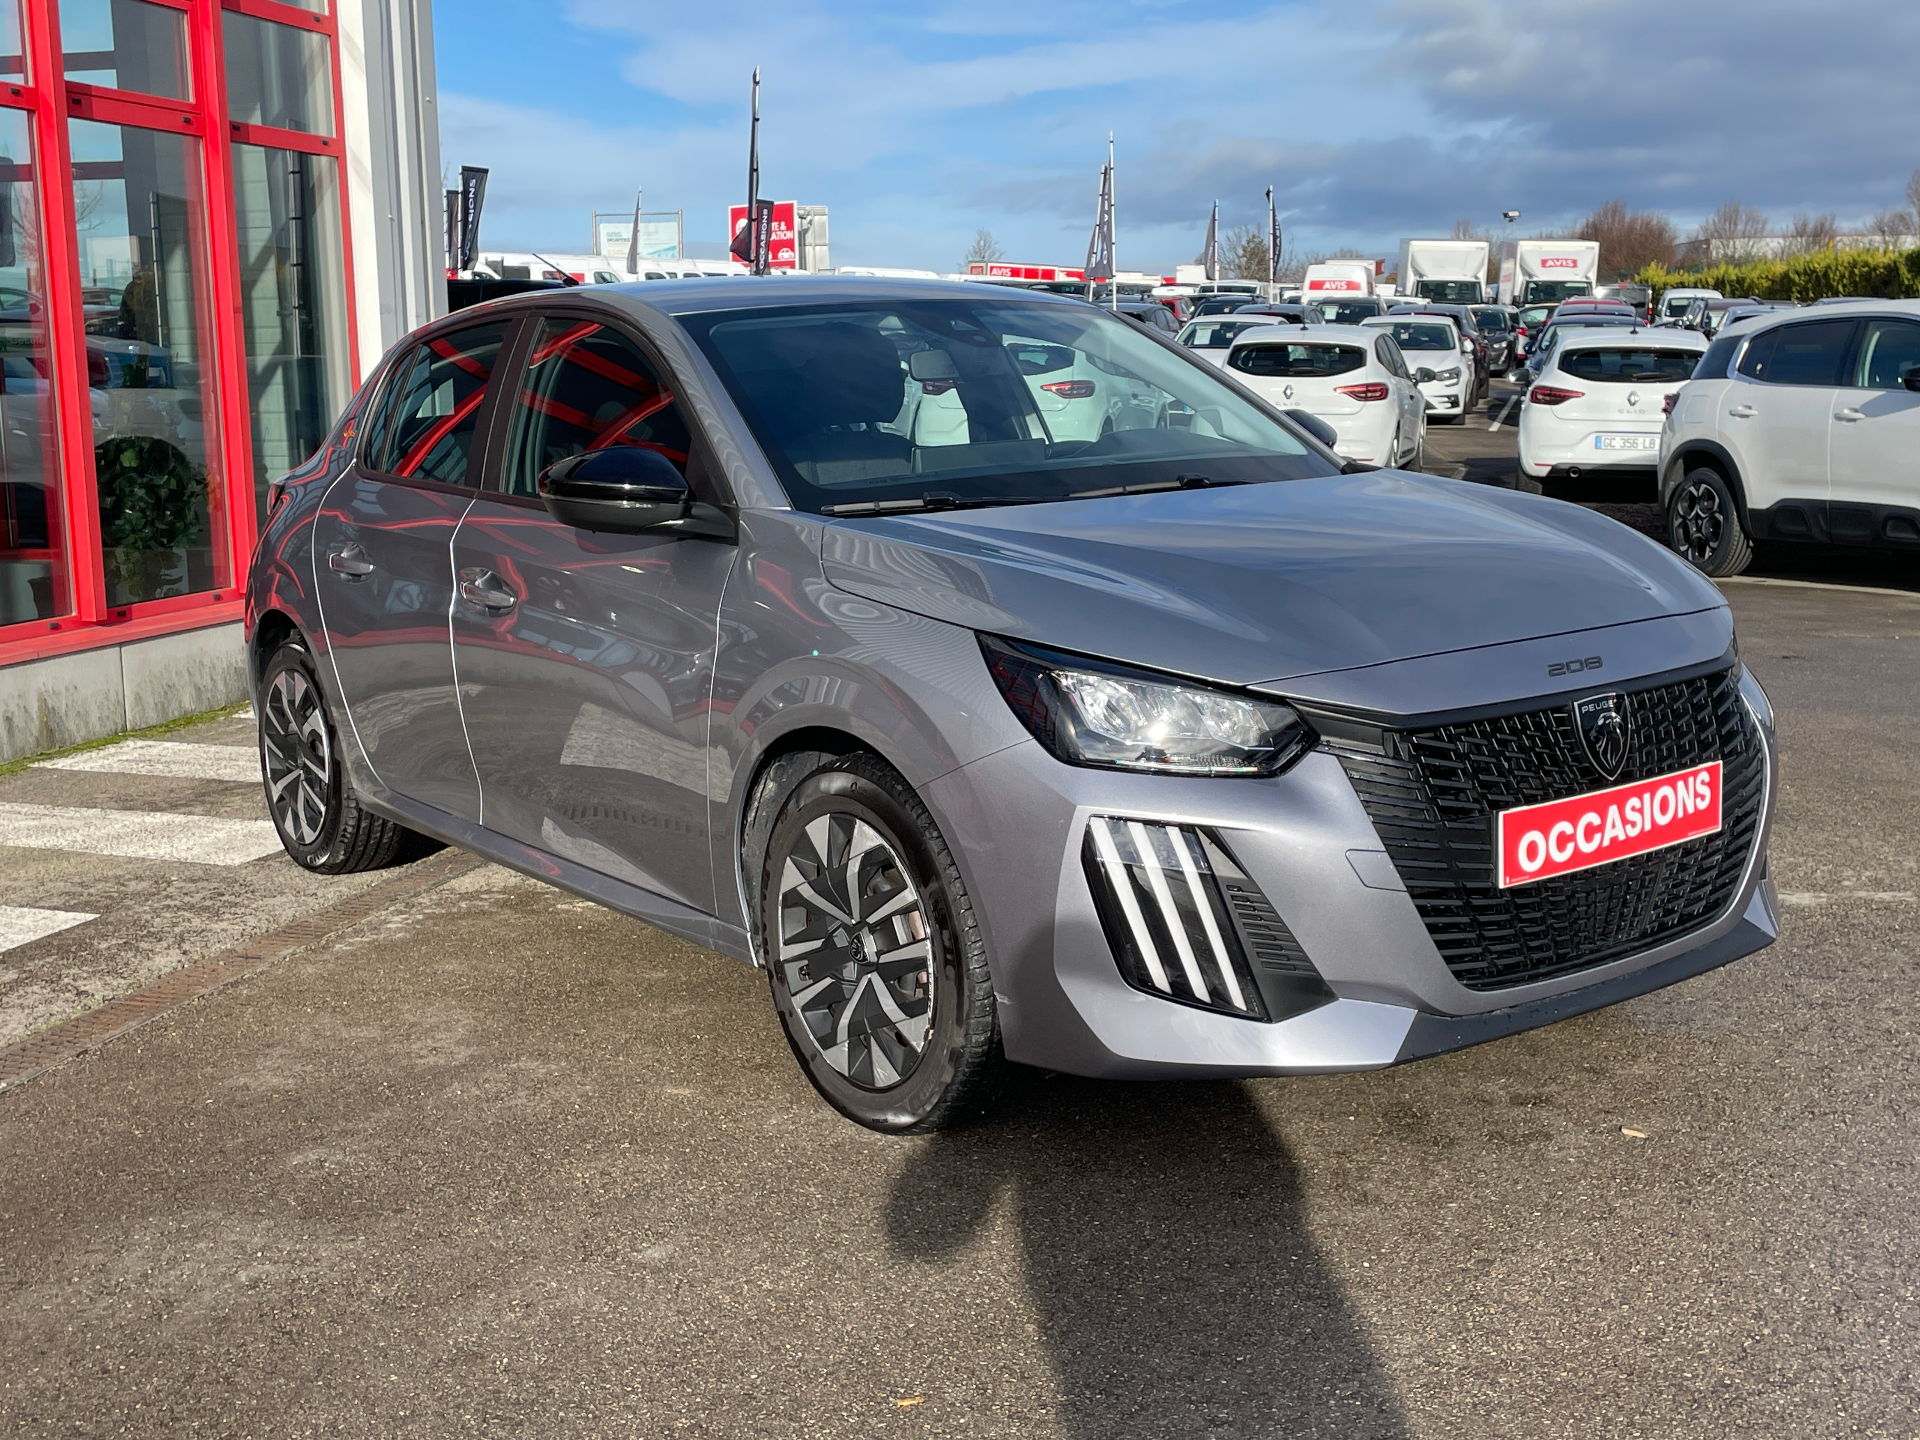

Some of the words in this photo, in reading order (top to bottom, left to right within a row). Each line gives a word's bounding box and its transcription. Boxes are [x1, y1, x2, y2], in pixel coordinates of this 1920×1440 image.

[759, 209, 768, 269] OCCASIONS
[1545, 259, 1574, 268] AVIS
[991, 267, 1012, 277] AVIS
[1322, 281, 1348, 290] AVIS
[1547, 655, 1603, 678] 208
[1517, 770, 1712, 873] OCCASIONS
